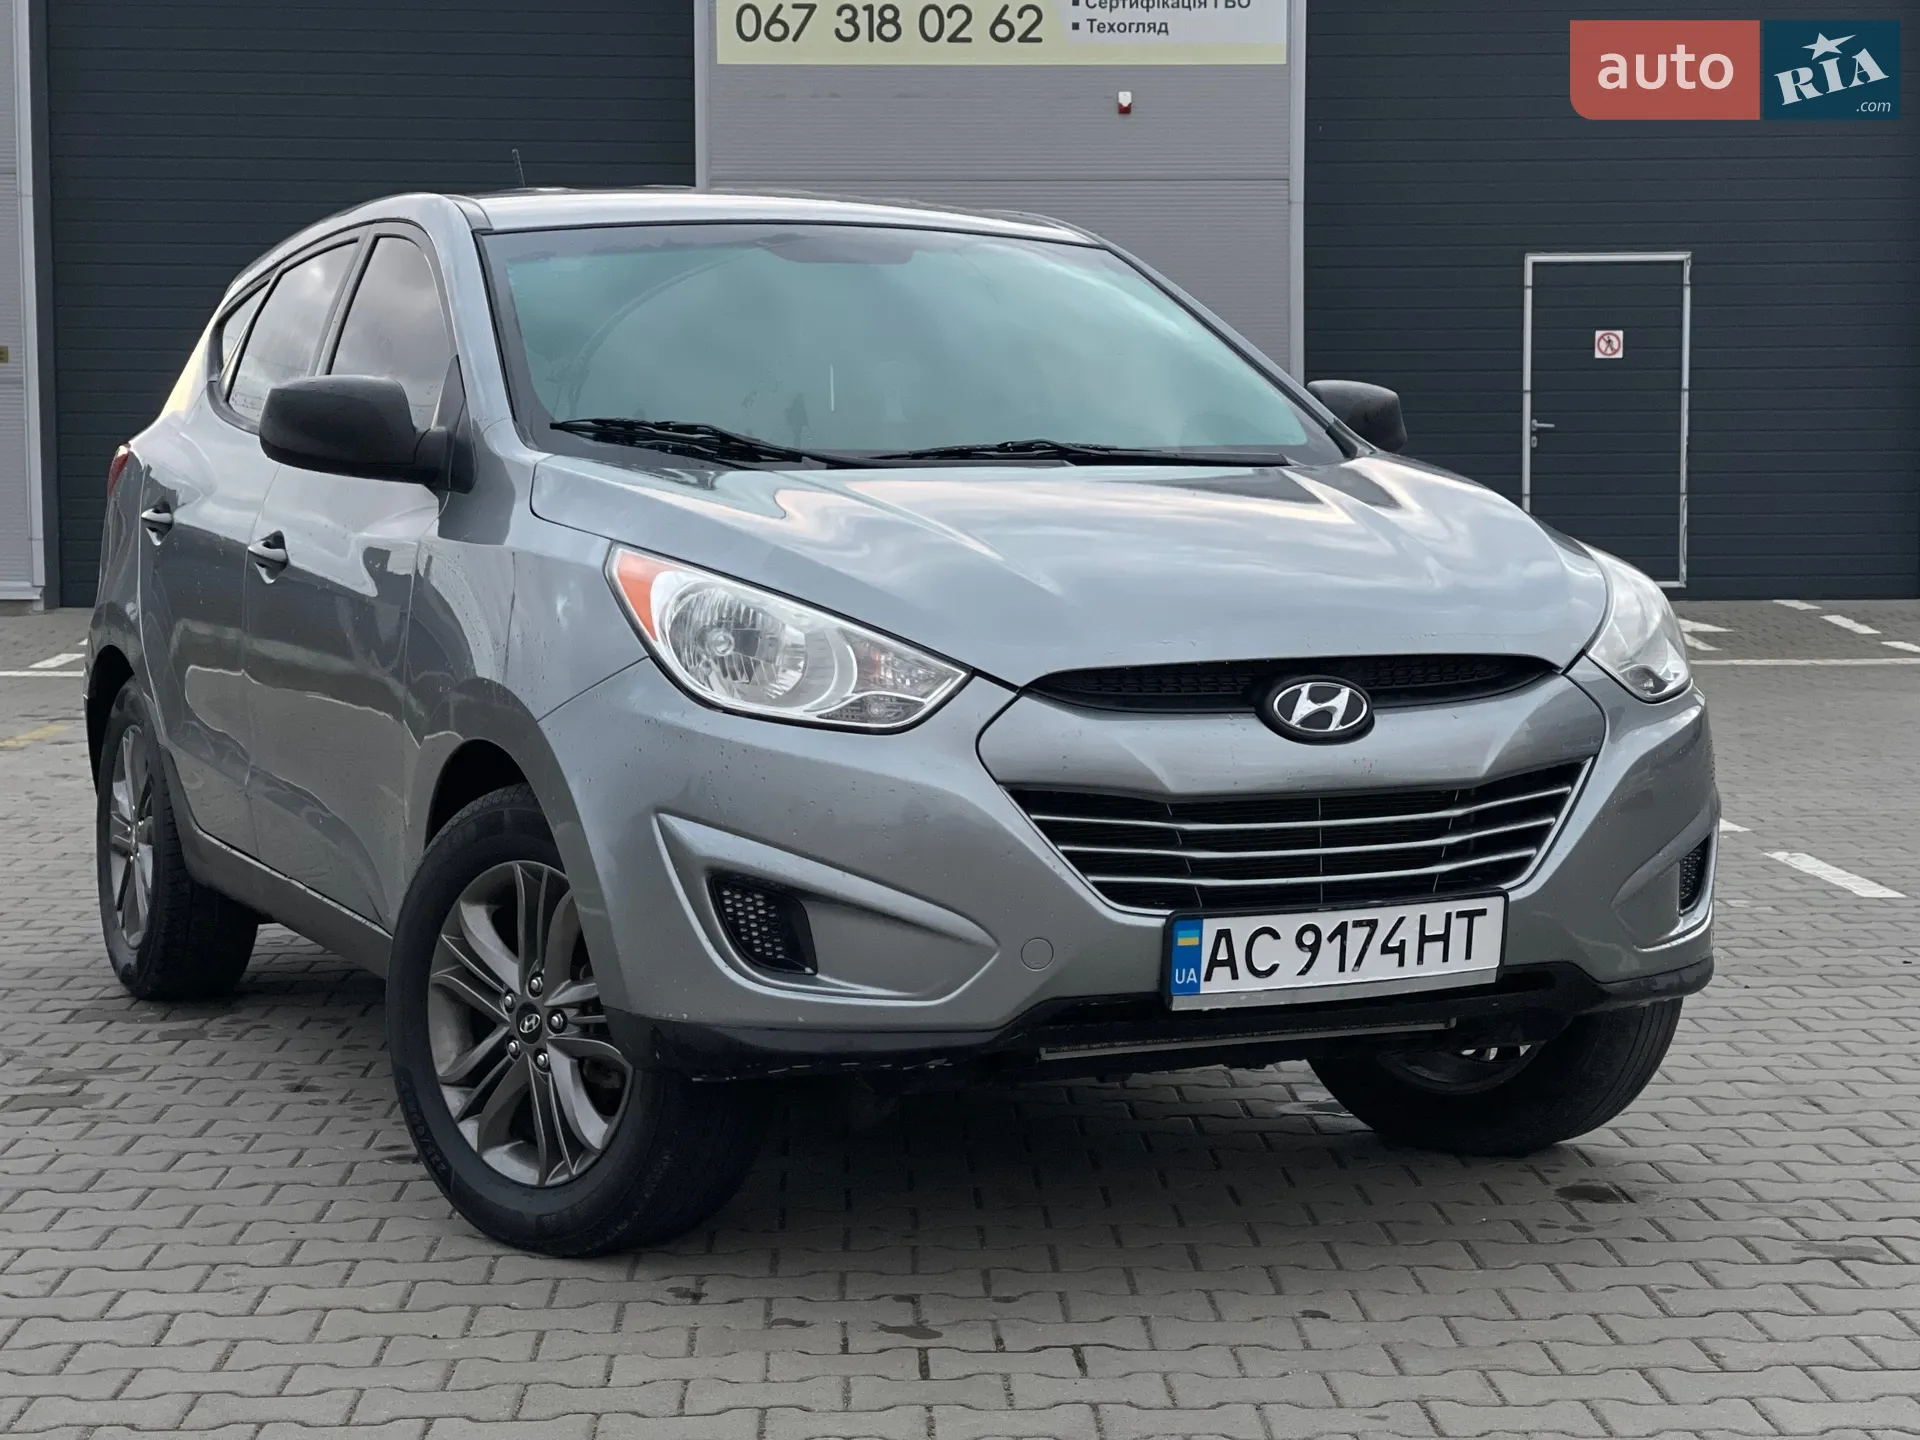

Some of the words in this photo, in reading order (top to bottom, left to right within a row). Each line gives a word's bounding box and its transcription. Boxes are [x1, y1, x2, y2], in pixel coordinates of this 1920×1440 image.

[736, 3, 818, 43] 067
[834, 3, 902, 43] 318
[918, 3, 973, 43] 02
[989, 3, 1043, 43] 62
[1086, 18, 1169, 36] Техогляд
[1175, 967, 1198, 985] UA
